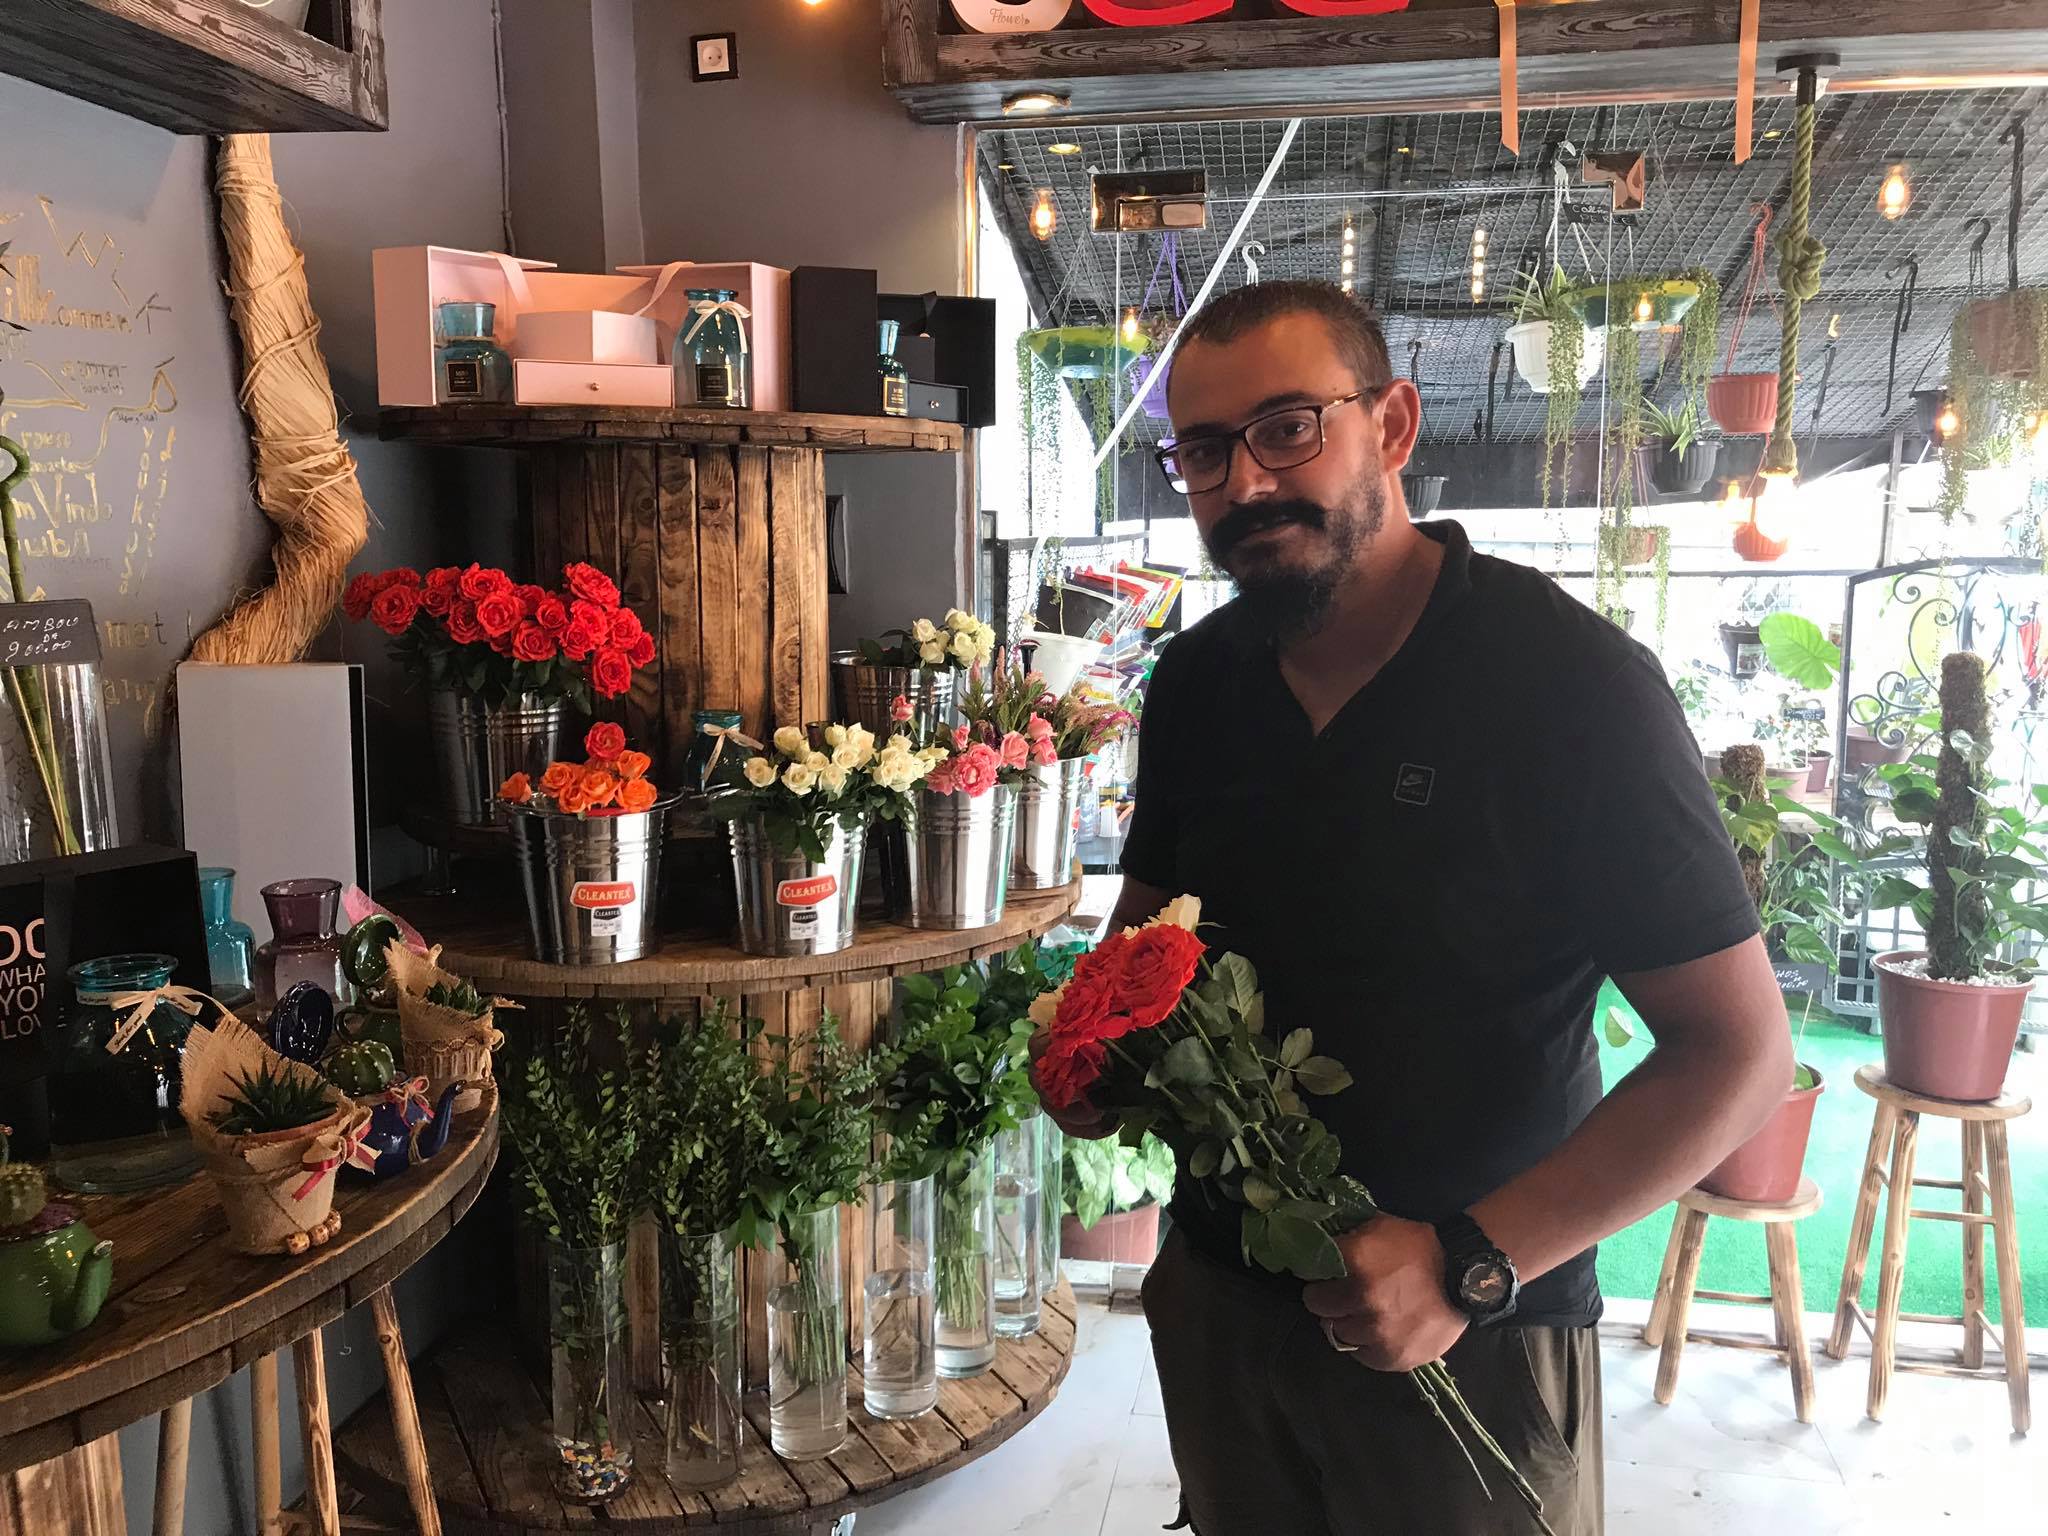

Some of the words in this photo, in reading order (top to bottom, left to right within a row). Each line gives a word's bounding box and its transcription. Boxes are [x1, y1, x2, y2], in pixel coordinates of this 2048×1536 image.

[577, 887, 631, 901] CLEANTEX
[783, 882, 834, 899] CLEANTEX
[0, 963, 46, 990] WHA
